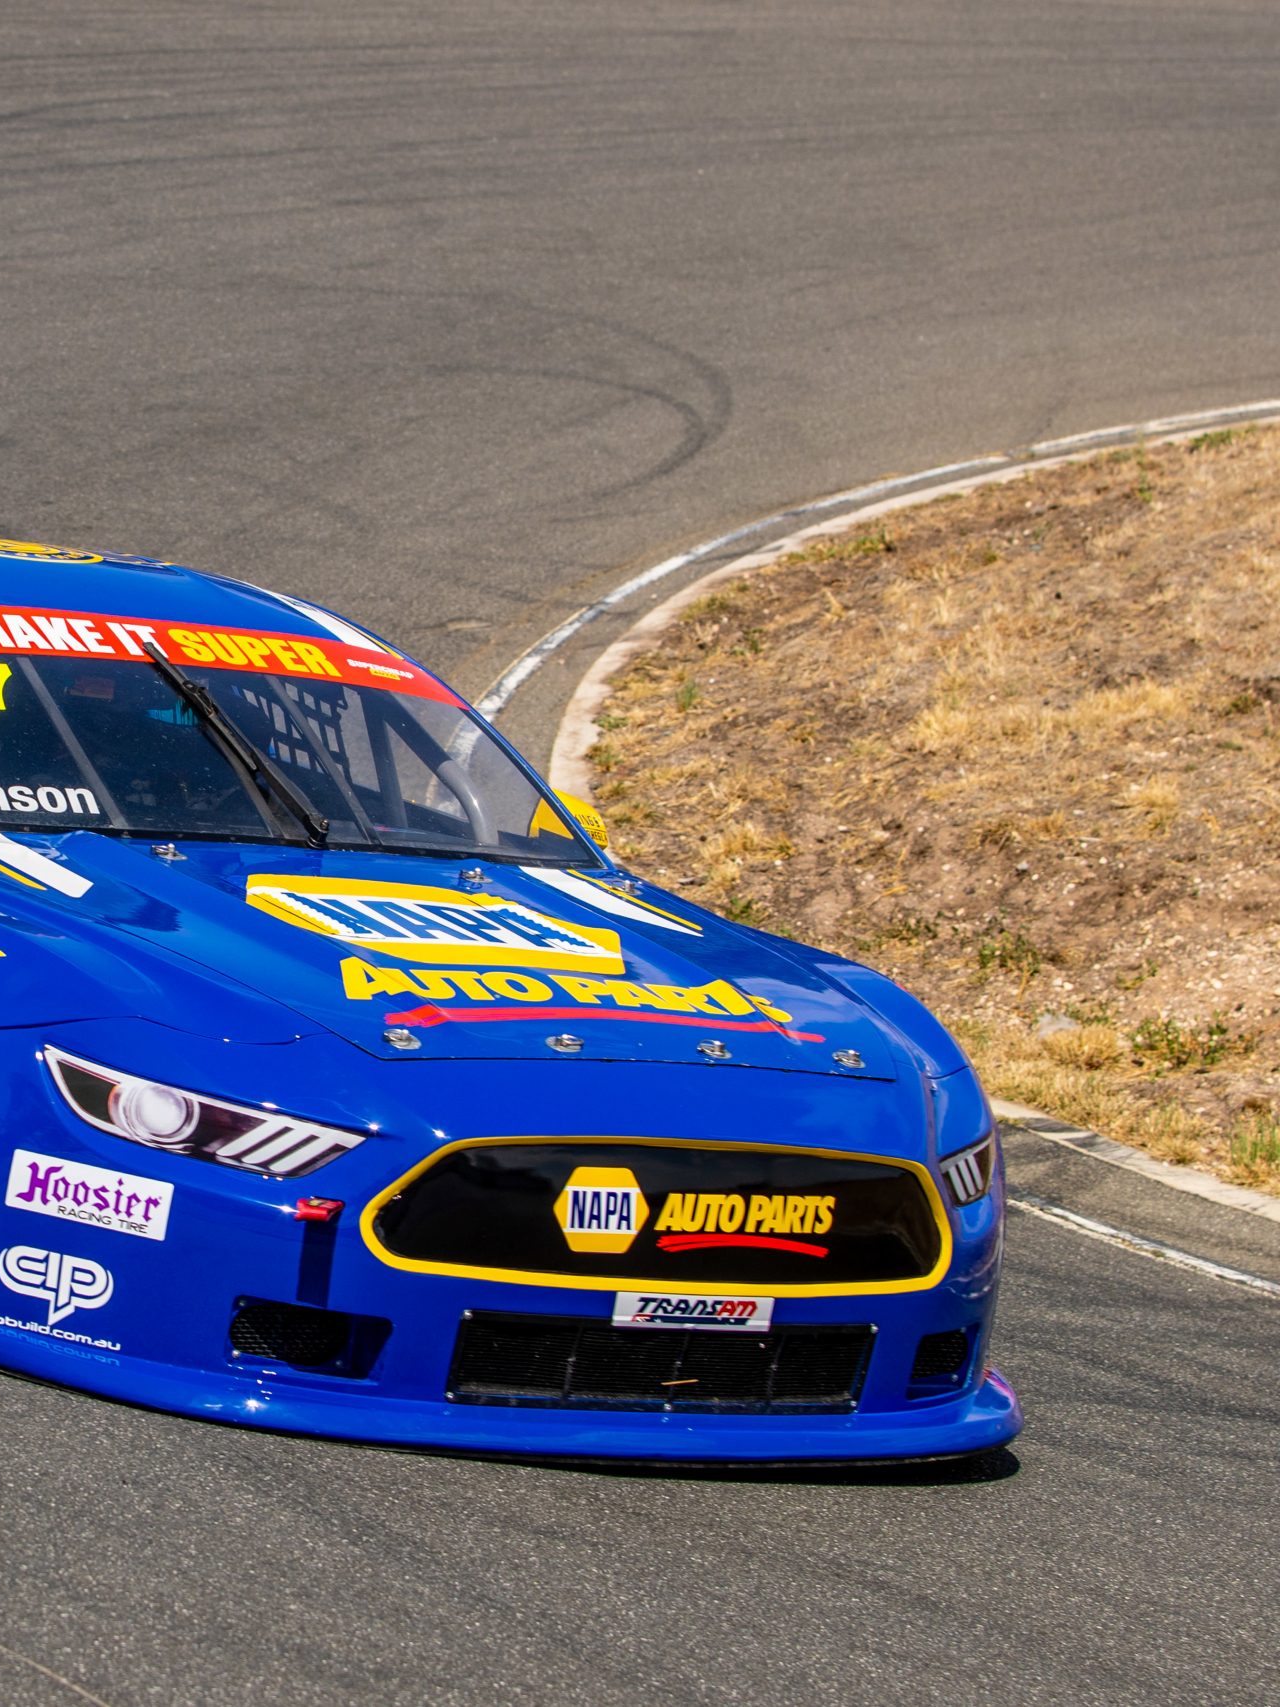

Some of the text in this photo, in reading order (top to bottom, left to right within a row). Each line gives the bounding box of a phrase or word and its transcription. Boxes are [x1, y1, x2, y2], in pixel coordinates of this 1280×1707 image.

[113, 622, 169, 659] IT
[167, 628, 343, 678] SUPER
[280, 892, 597, 949] NAPA
[339, 957, 794, 1024] AUTO PARTS
[15, 1161, 161, 1222] Hoosier
[57, 1204, 149, 1234] RACING TIRE
[570, 1190, 632, 1231] NAPA
[654, 1193, 836, 1235] AUTO PARTS
